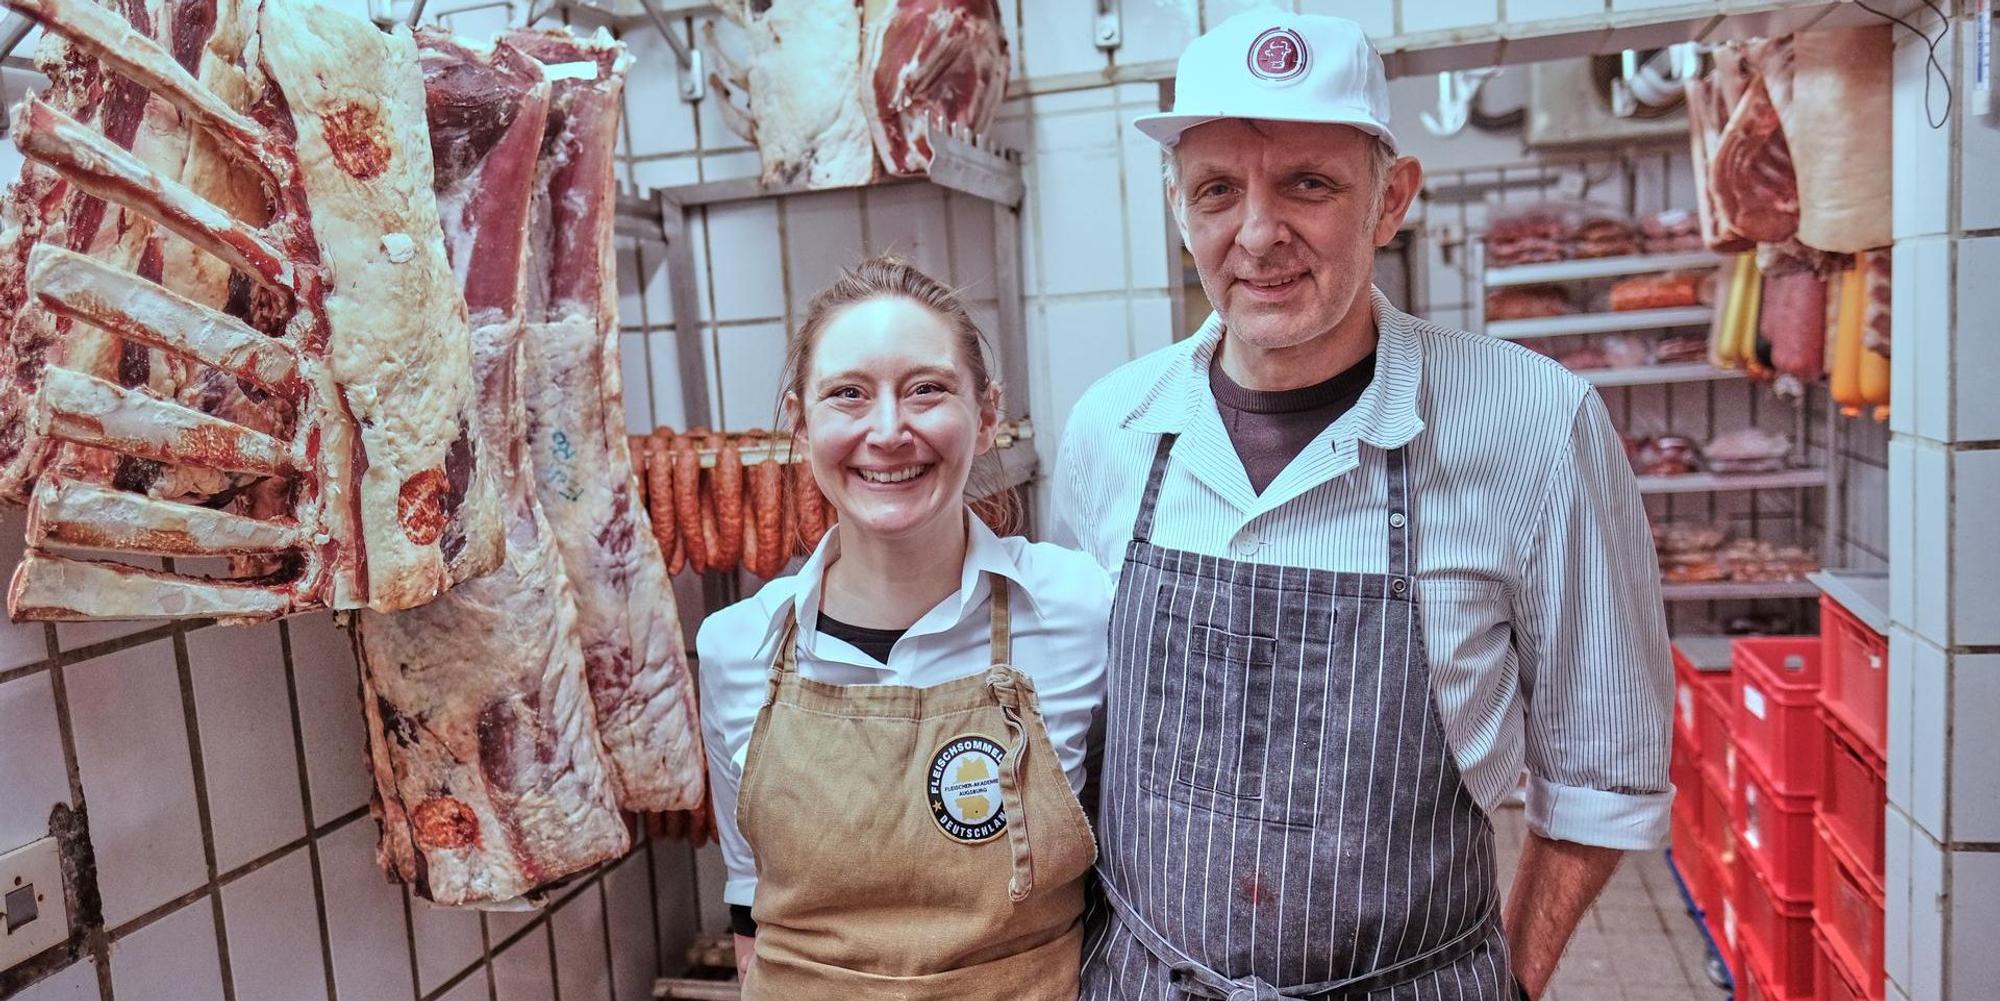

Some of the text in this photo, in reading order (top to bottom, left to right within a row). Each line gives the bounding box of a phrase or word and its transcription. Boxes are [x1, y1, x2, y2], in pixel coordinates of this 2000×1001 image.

[931, 740, 1003, 795] FLEISCHSOMMEL
[959, 787, 988, 797] AUGSBURG
[940, 811, 1007, 838] DEUTSCHLAN
